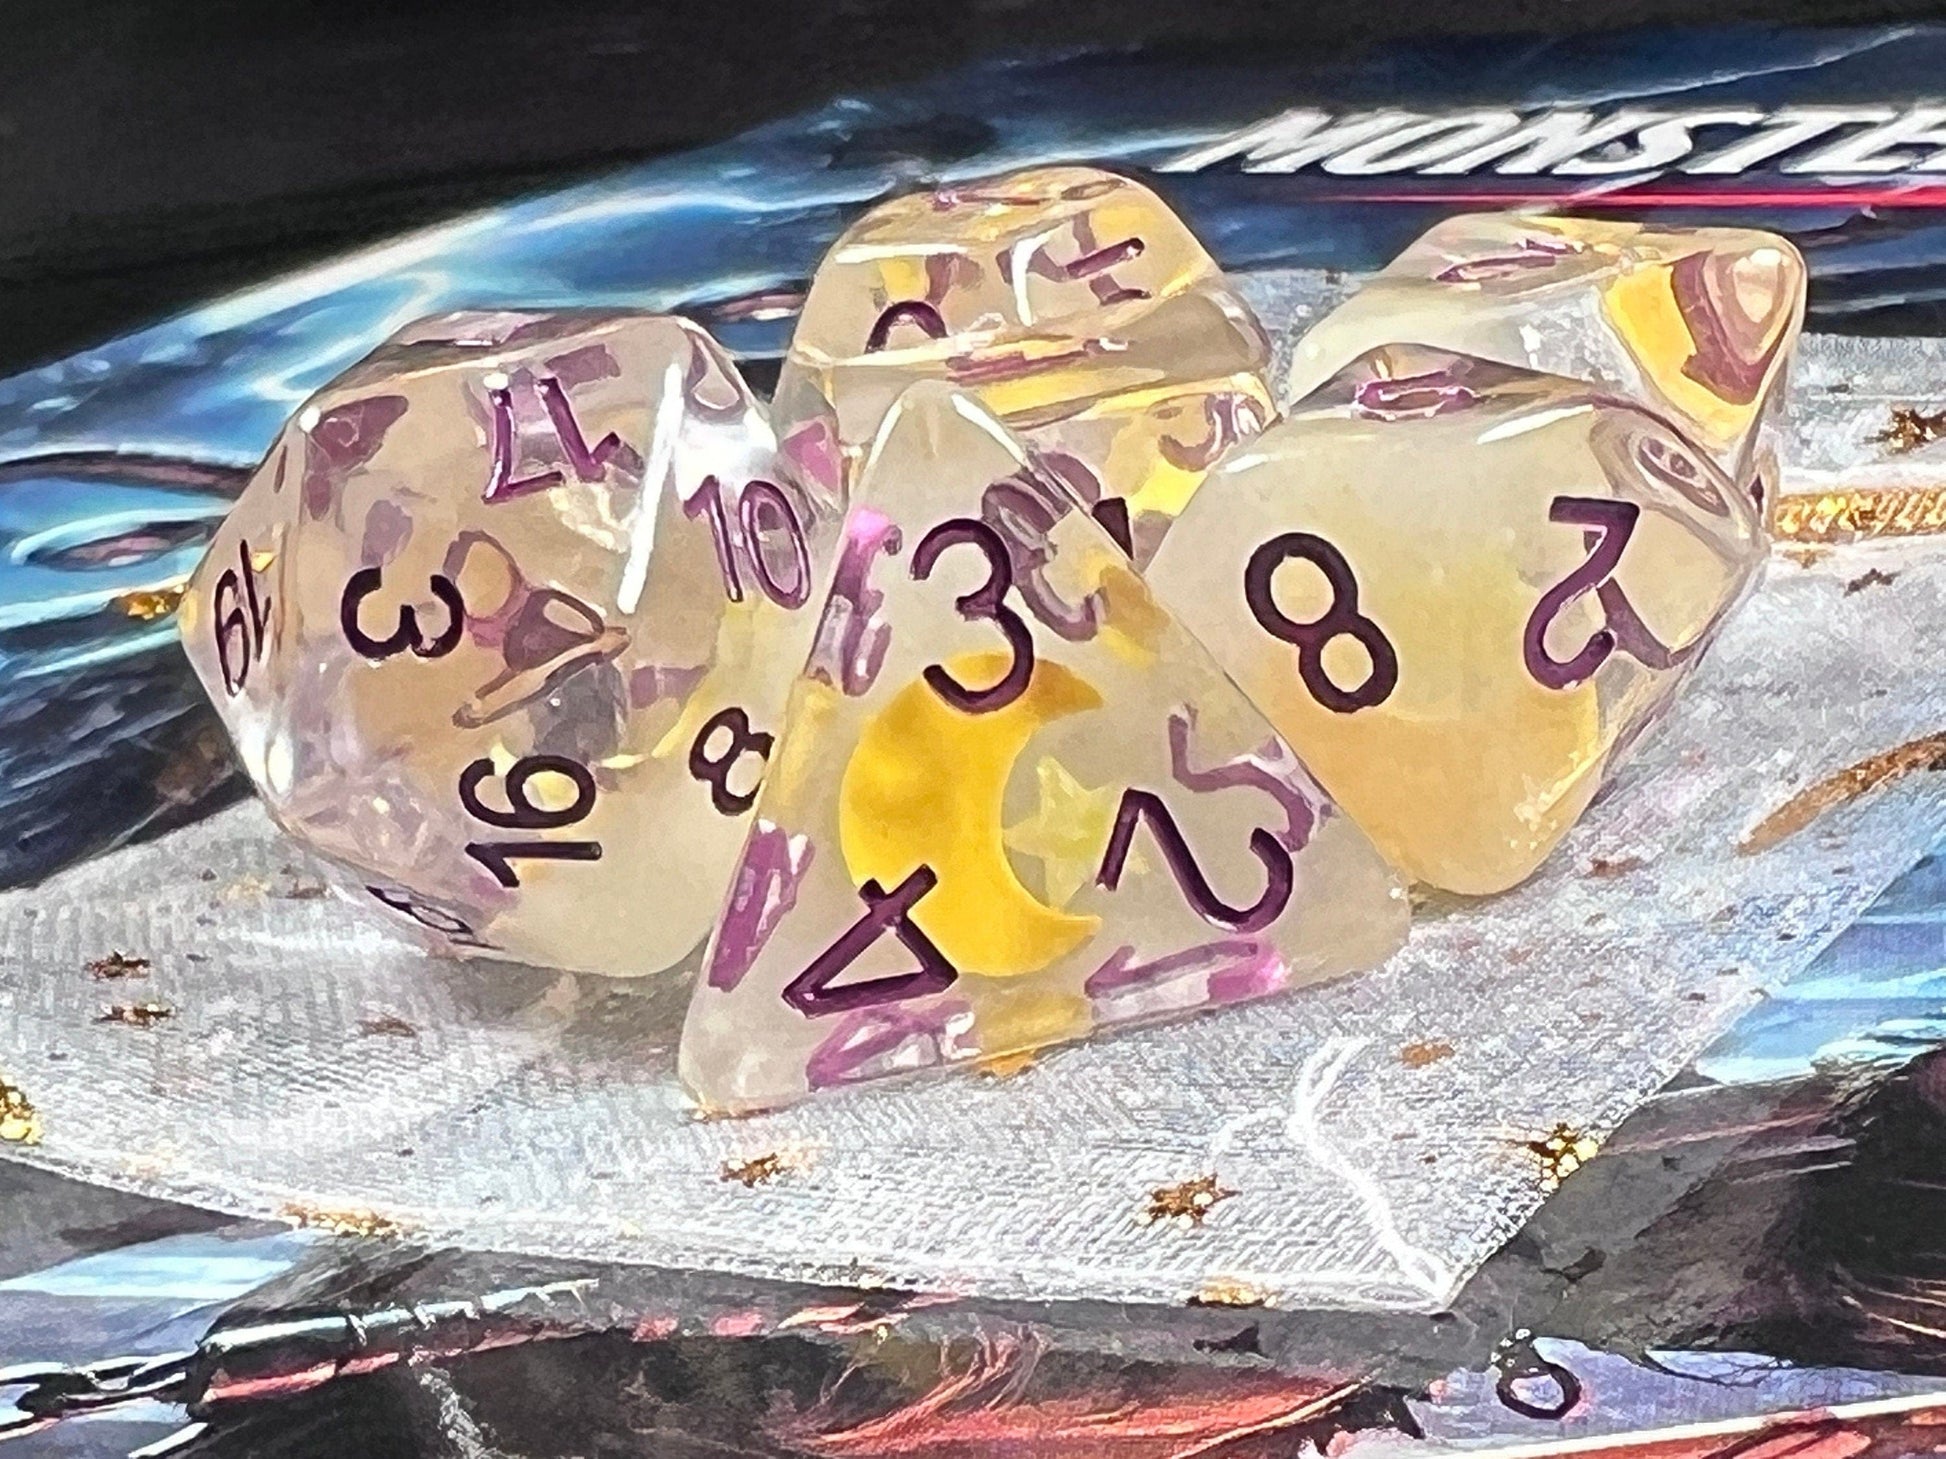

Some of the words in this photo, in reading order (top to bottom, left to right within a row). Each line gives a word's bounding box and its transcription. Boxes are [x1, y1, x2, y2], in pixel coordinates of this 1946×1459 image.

[1150, 104, 1946, 174] MONSTE
[684, 474, 811, 610] 10
[340, 567, 464, 658] 3
[909, 517, 1035, 713] 3
[1245, 532, 1398, 713] 8
[458, 755, 604, 888] 16
[689, 707, 774, 816] 8
[1096, 788, 1294, 933] 2
[782, 864, 959, 1018] 4
